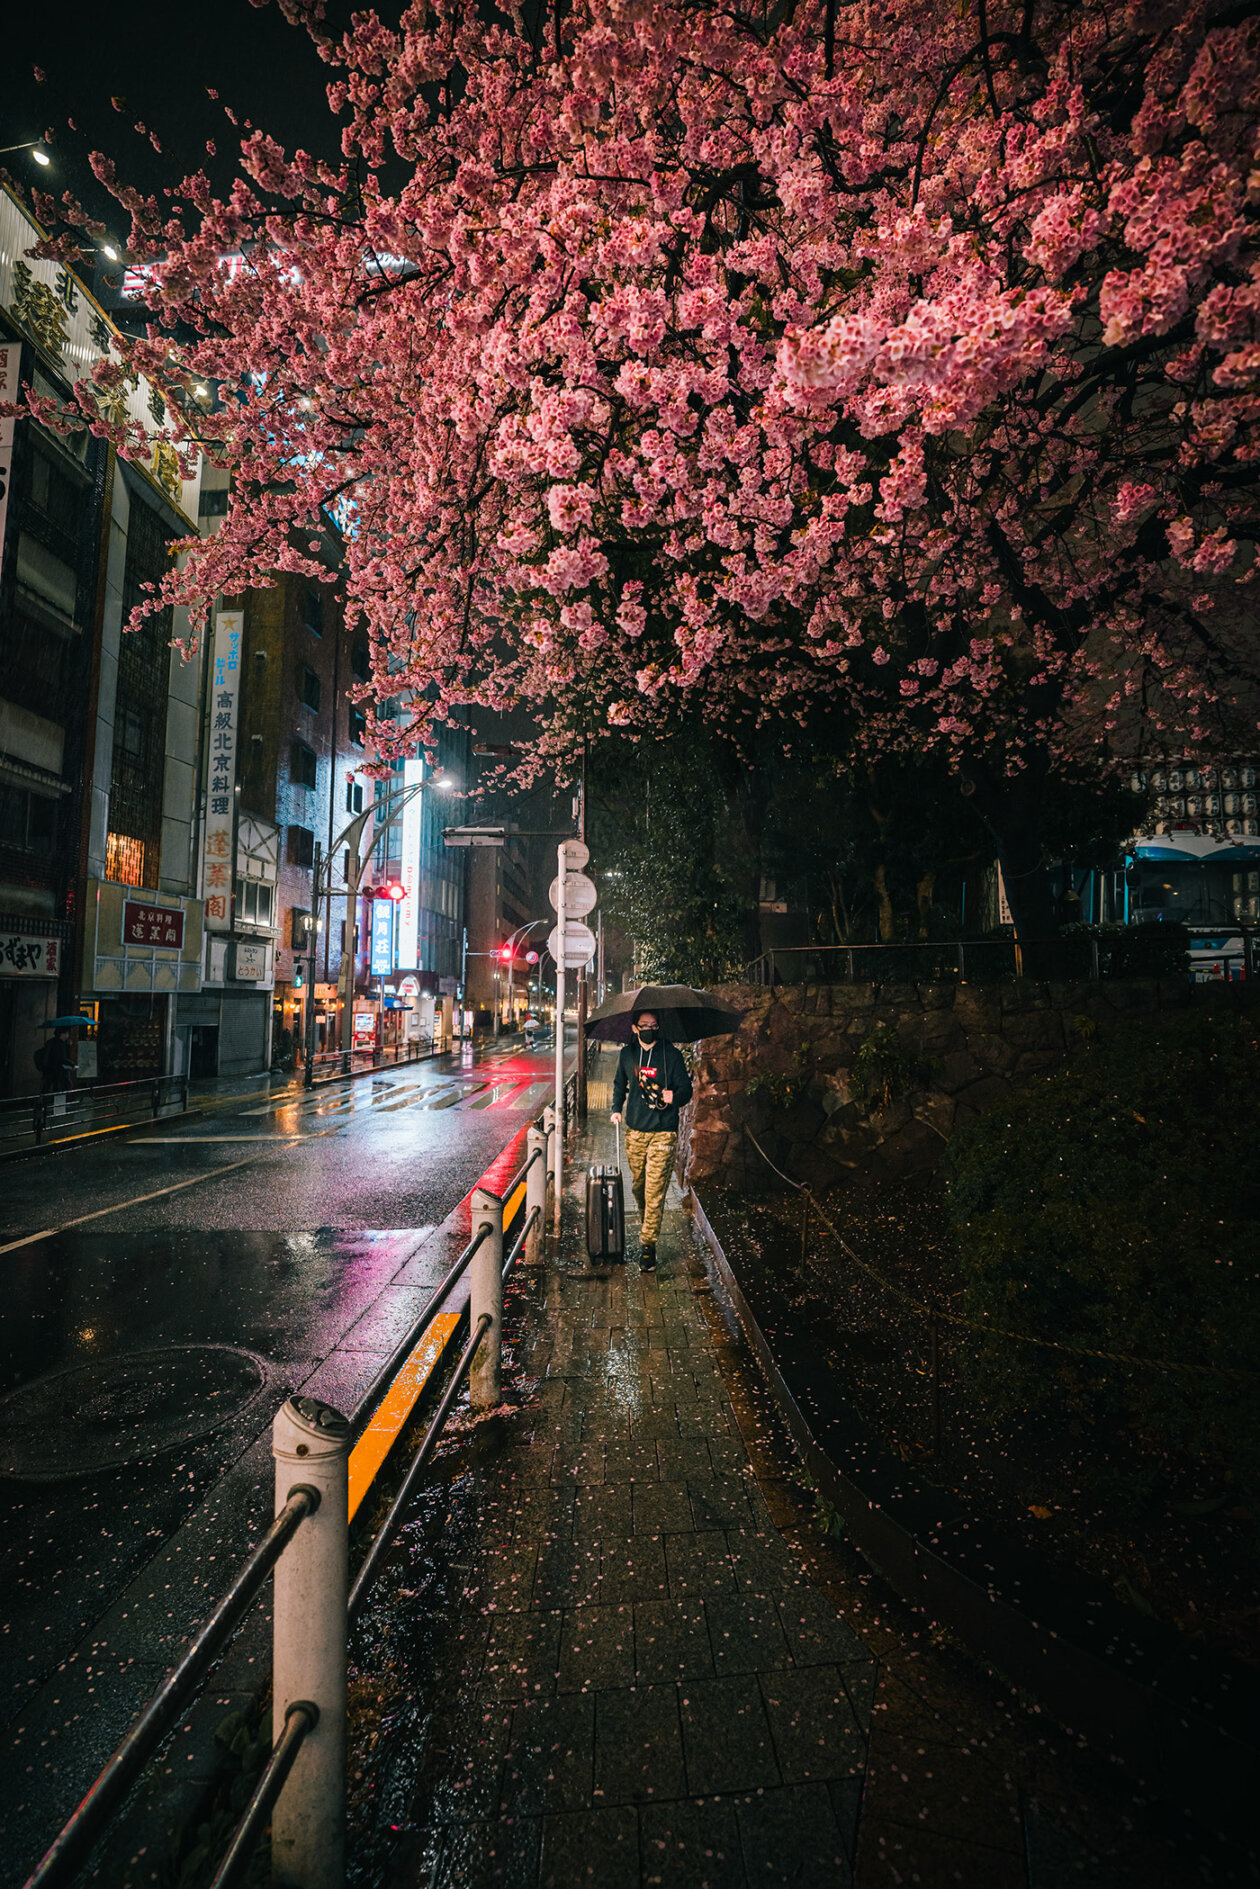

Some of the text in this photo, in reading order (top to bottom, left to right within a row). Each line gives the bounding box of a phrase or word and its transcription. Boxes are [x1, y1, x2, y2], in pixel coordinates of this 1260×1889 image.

[228, 632, 240, 671] サッポロ
[215, 657, 226, 686] ビール
[211, 690, 234, 815] 高級北京料理
[137, 910, 173, 925] 北京料理
[0, 936, 42, 971] ずまや
